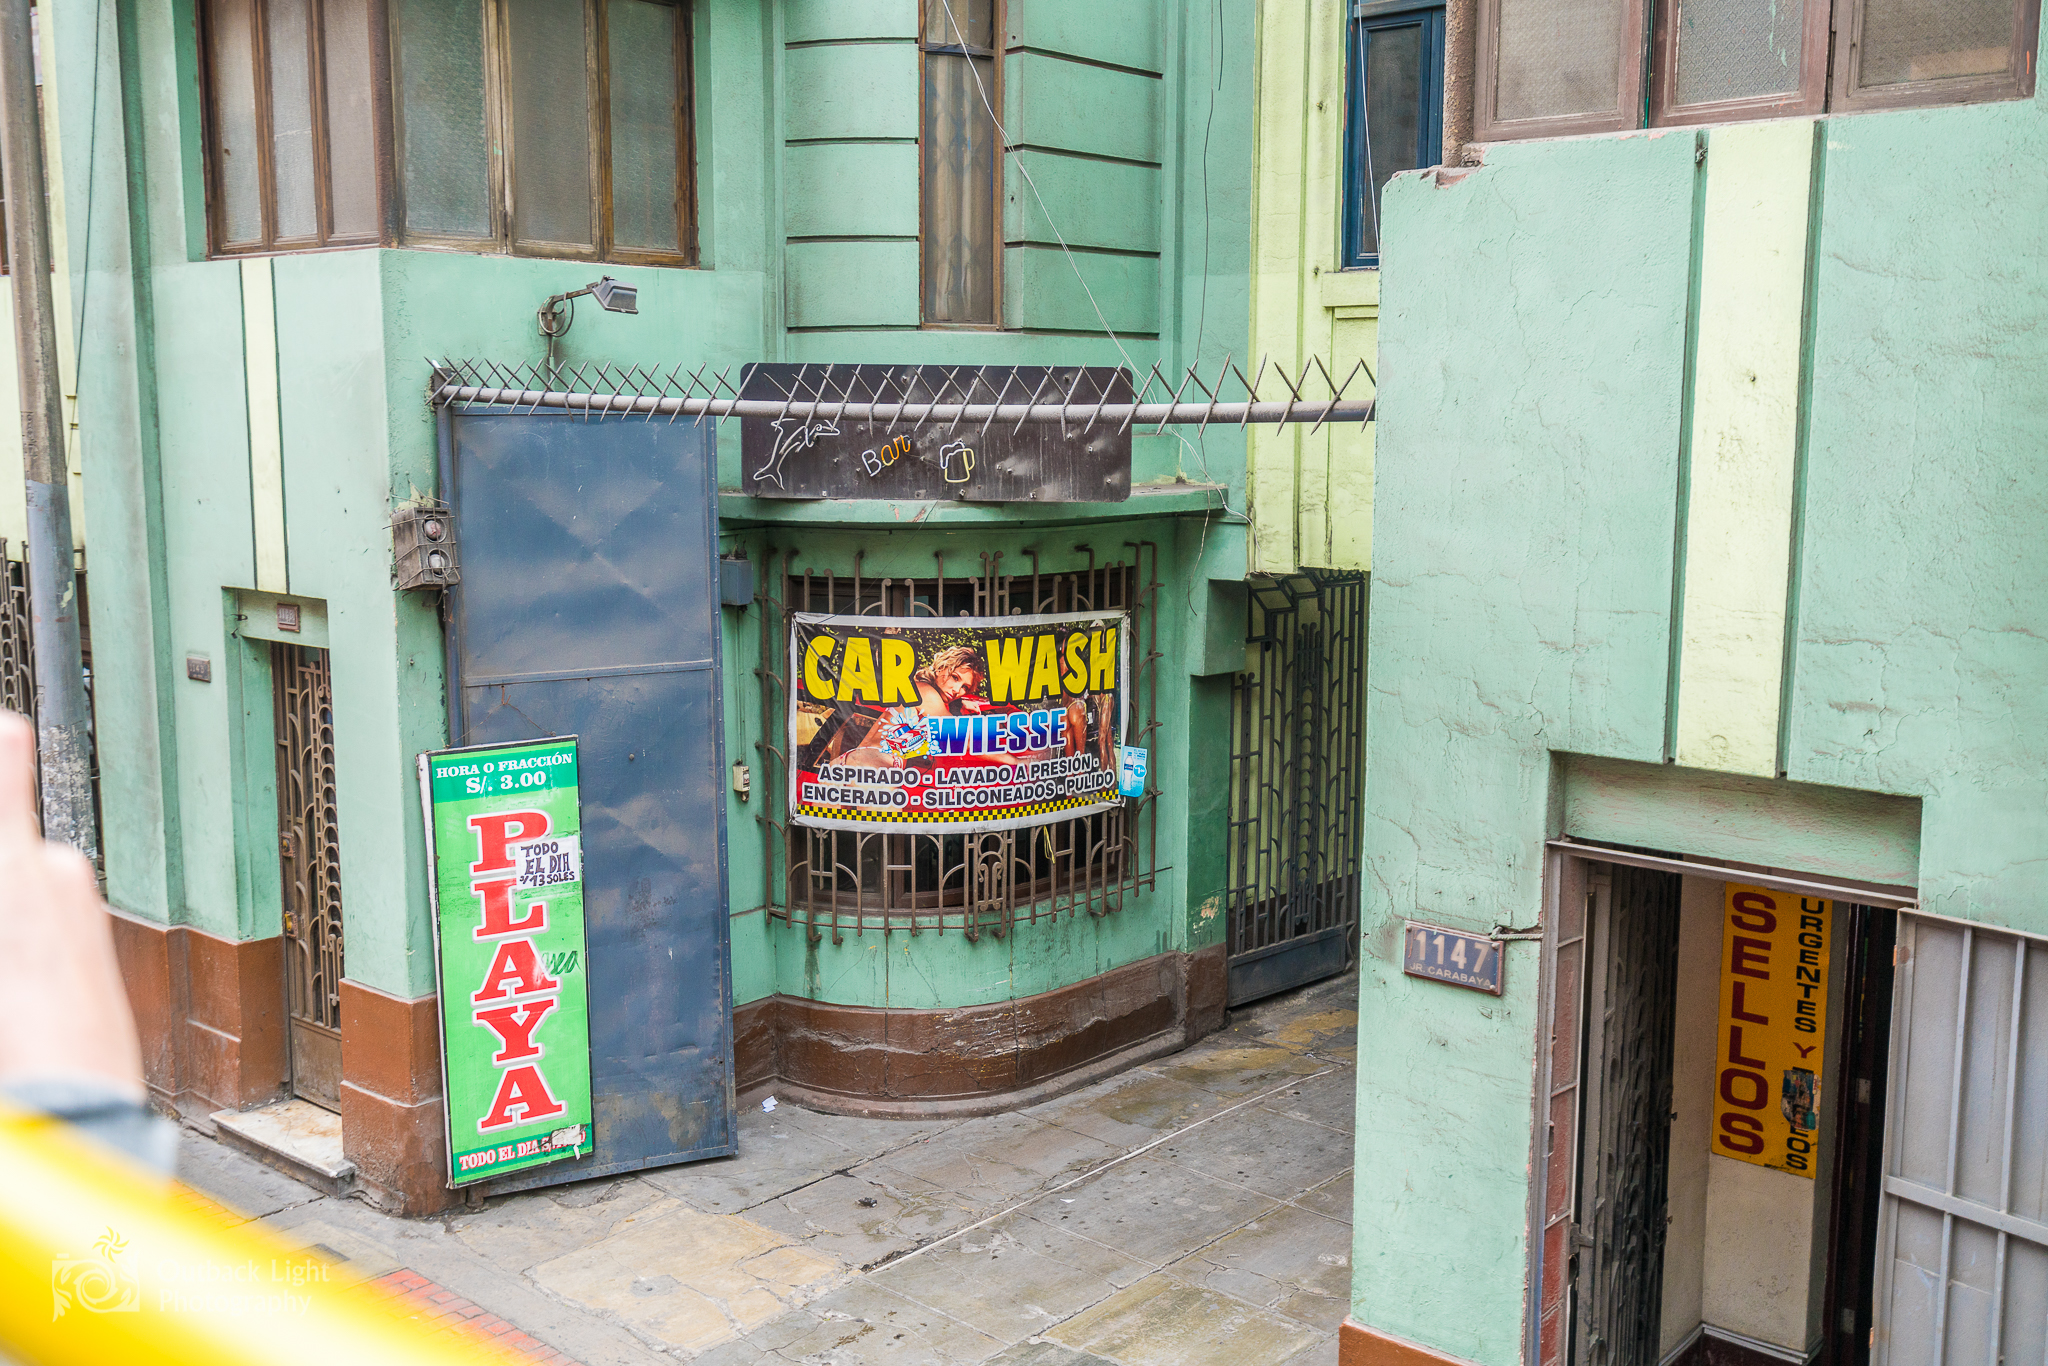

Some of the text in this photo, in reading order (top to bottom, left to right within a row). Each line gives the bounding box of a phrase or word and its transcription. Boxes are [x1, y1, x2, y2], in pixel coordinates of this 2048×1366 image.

[862, 435, 912, 476] Bar
[804, 628, 1117, 704] CAR WASH
[929, 708, 1067, 756] WIESSE
[436, 752, 573, 778] HORA O FRACCIÓN
[820, 766, 919, 785] ASPIRADO
[937, 767, 1011, 785] LAVADO
[1016, 766, 1027, 781] A
[1030, 752, 1091, 779] PRESIÓN
[466, 771, 546, 794] S/. 3.00
[804, 785, 906, 806] ENCERADO
[925, 784, 1055, 806] SILICONEADOS
[1066, 772, 1114, 793] PULIDO
[520, 841, 559, 857] TODO
[525, 852, 570, 875] EL DIA
[546, 871, 575, 884] SOLES
[1416, 931, 1490, 973] 1147
[1794, 898, 1824, 1033] URGENTES
[468, 810, 565, 1132] PLAYA
[1410, 962, 1491, 986] JR. CARABAYA
[1719, 891, 1777, 1155] SELLOS
[1792, 1042, 1817, 1058] Y
[459, 1150, 496, 1171] TODO
[498, 1144, 516, 1163] EL
[517, 1138, 539, 1157] DIA
